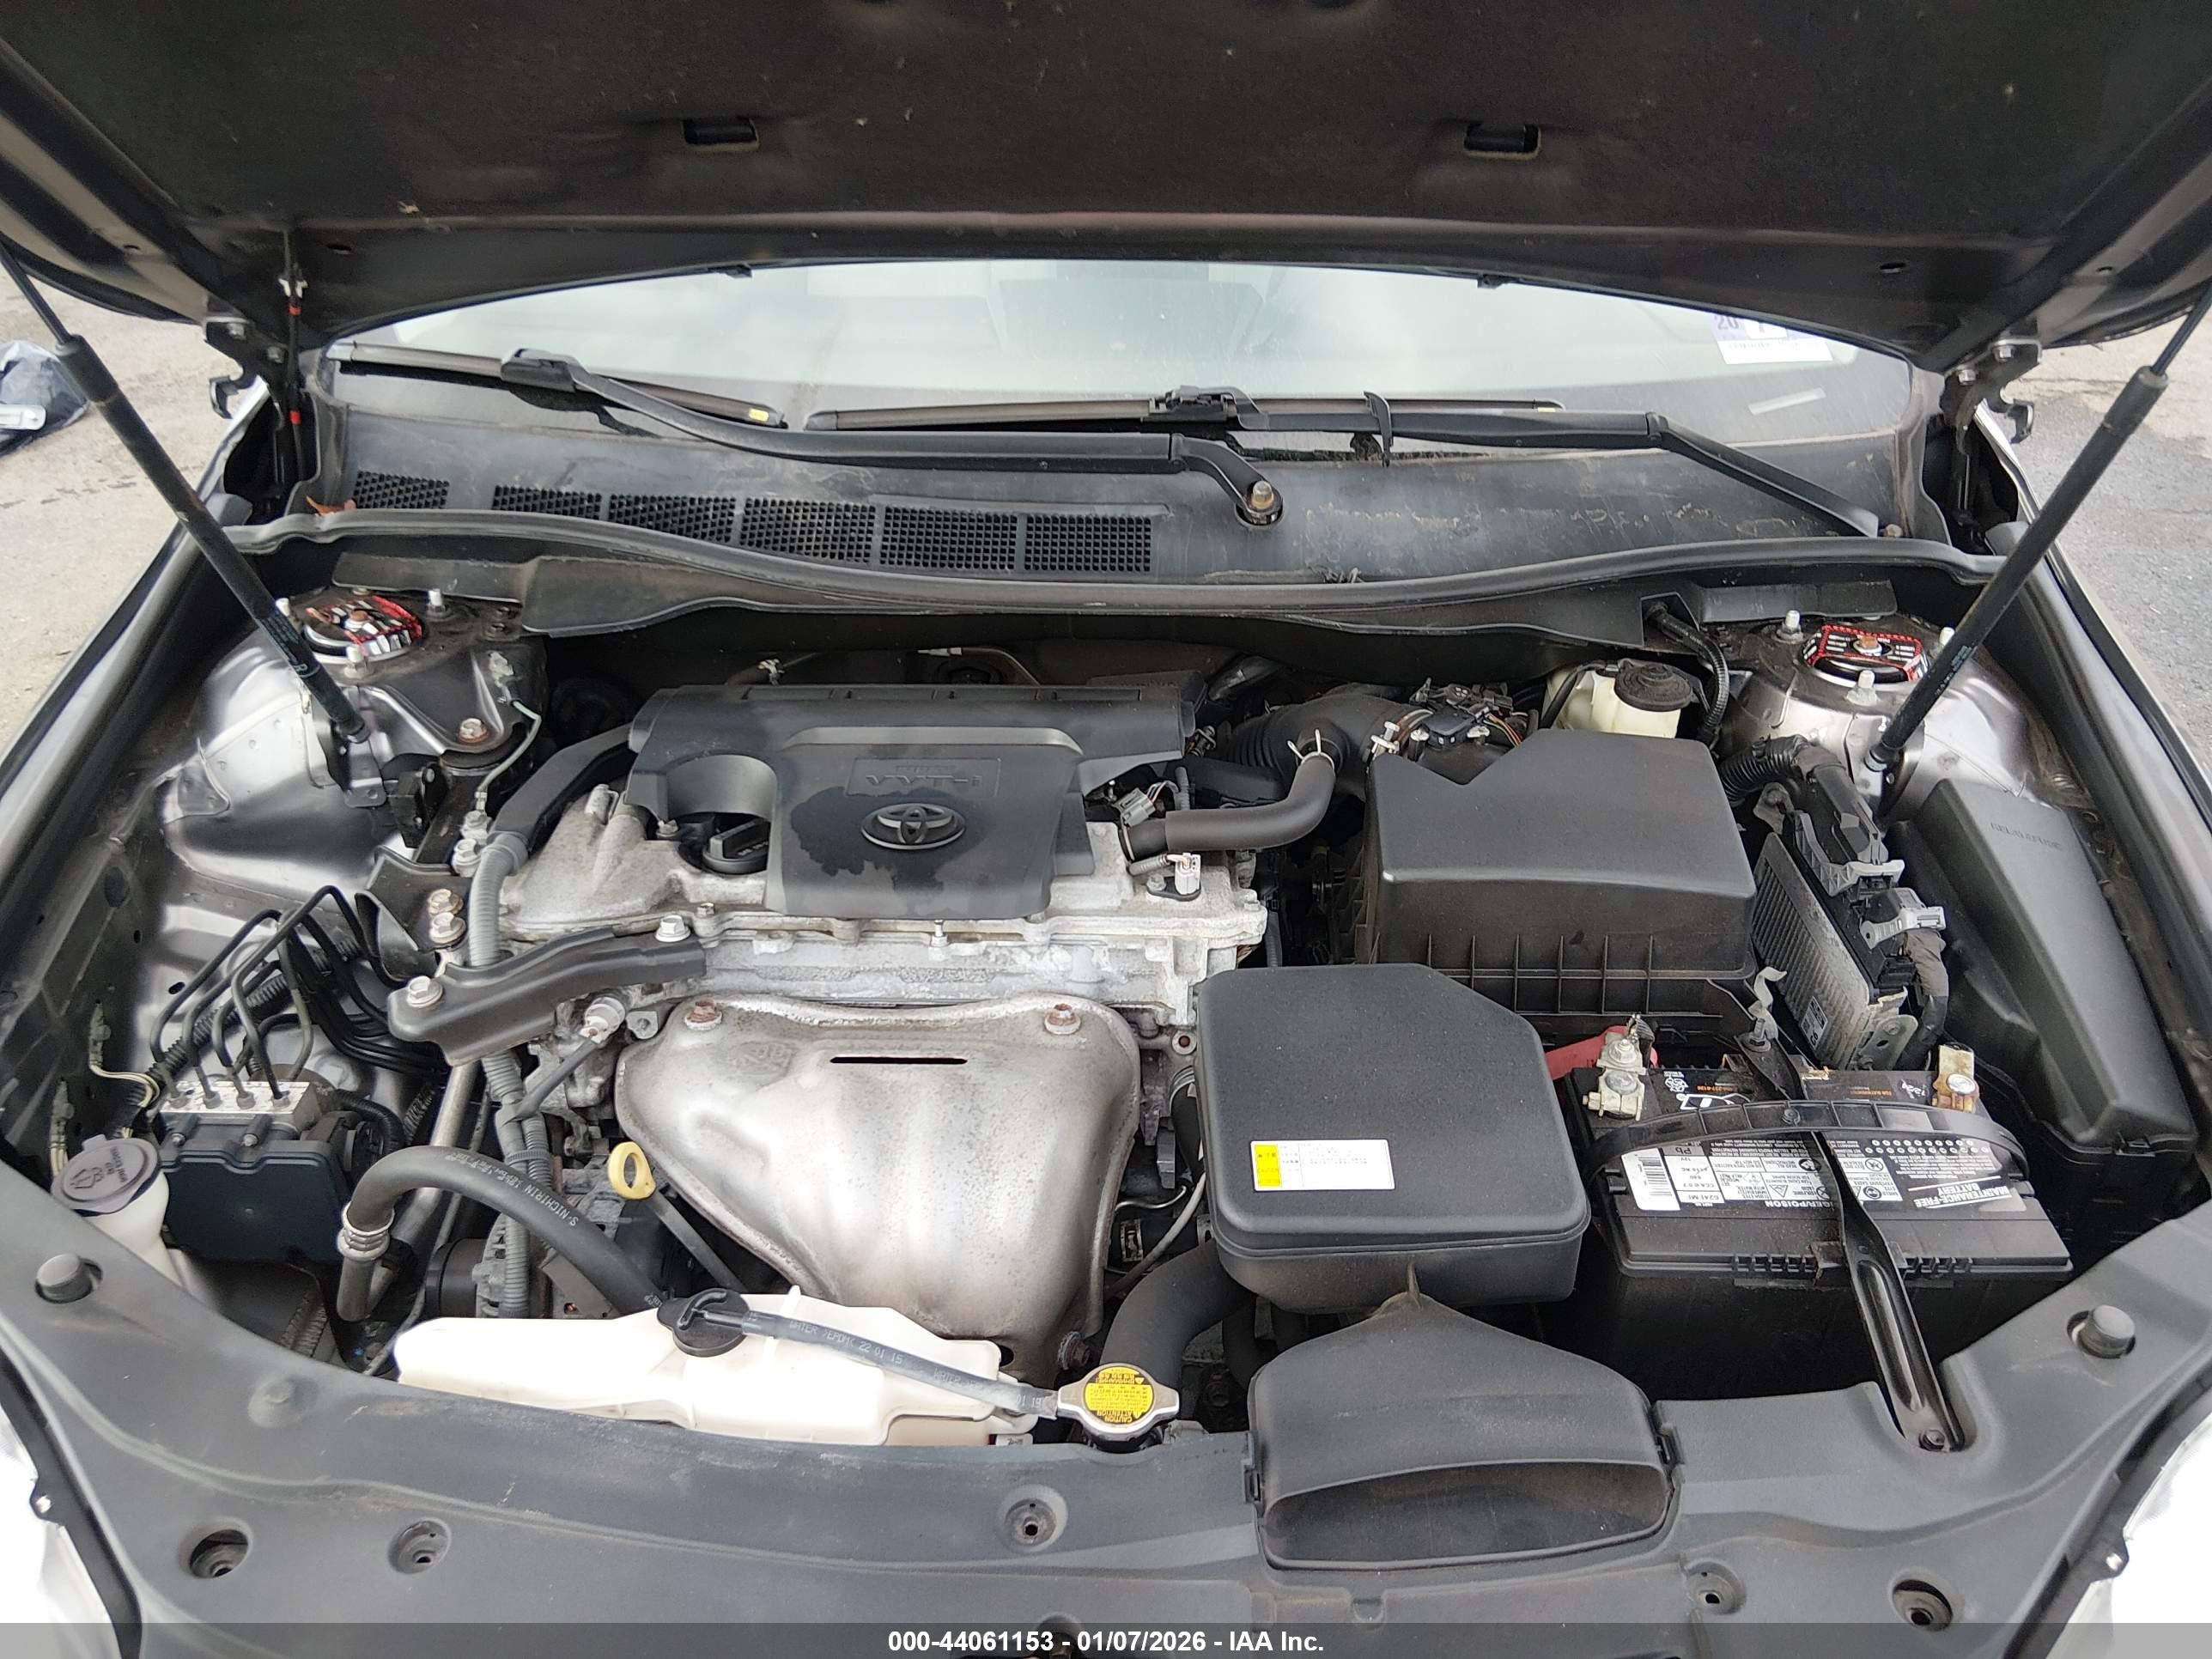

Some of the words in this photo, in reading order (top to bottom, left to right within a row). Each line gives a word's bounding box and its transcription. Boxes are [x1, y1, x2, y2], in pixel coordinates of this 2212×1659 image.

[1675, 1146, 1692, 1155] Pb
[1937, 1182, 1980, 1195] BATTERY
[1913, 1186, 2009, 1207] MAINTENANCE-FREE
[859, 1340, 872, 1352] 22
[874, 1347, 885, 1358] 01
[890, 1352, 903, 1364] 15
[1103, 1415, 1133, 1424] CAUTION
